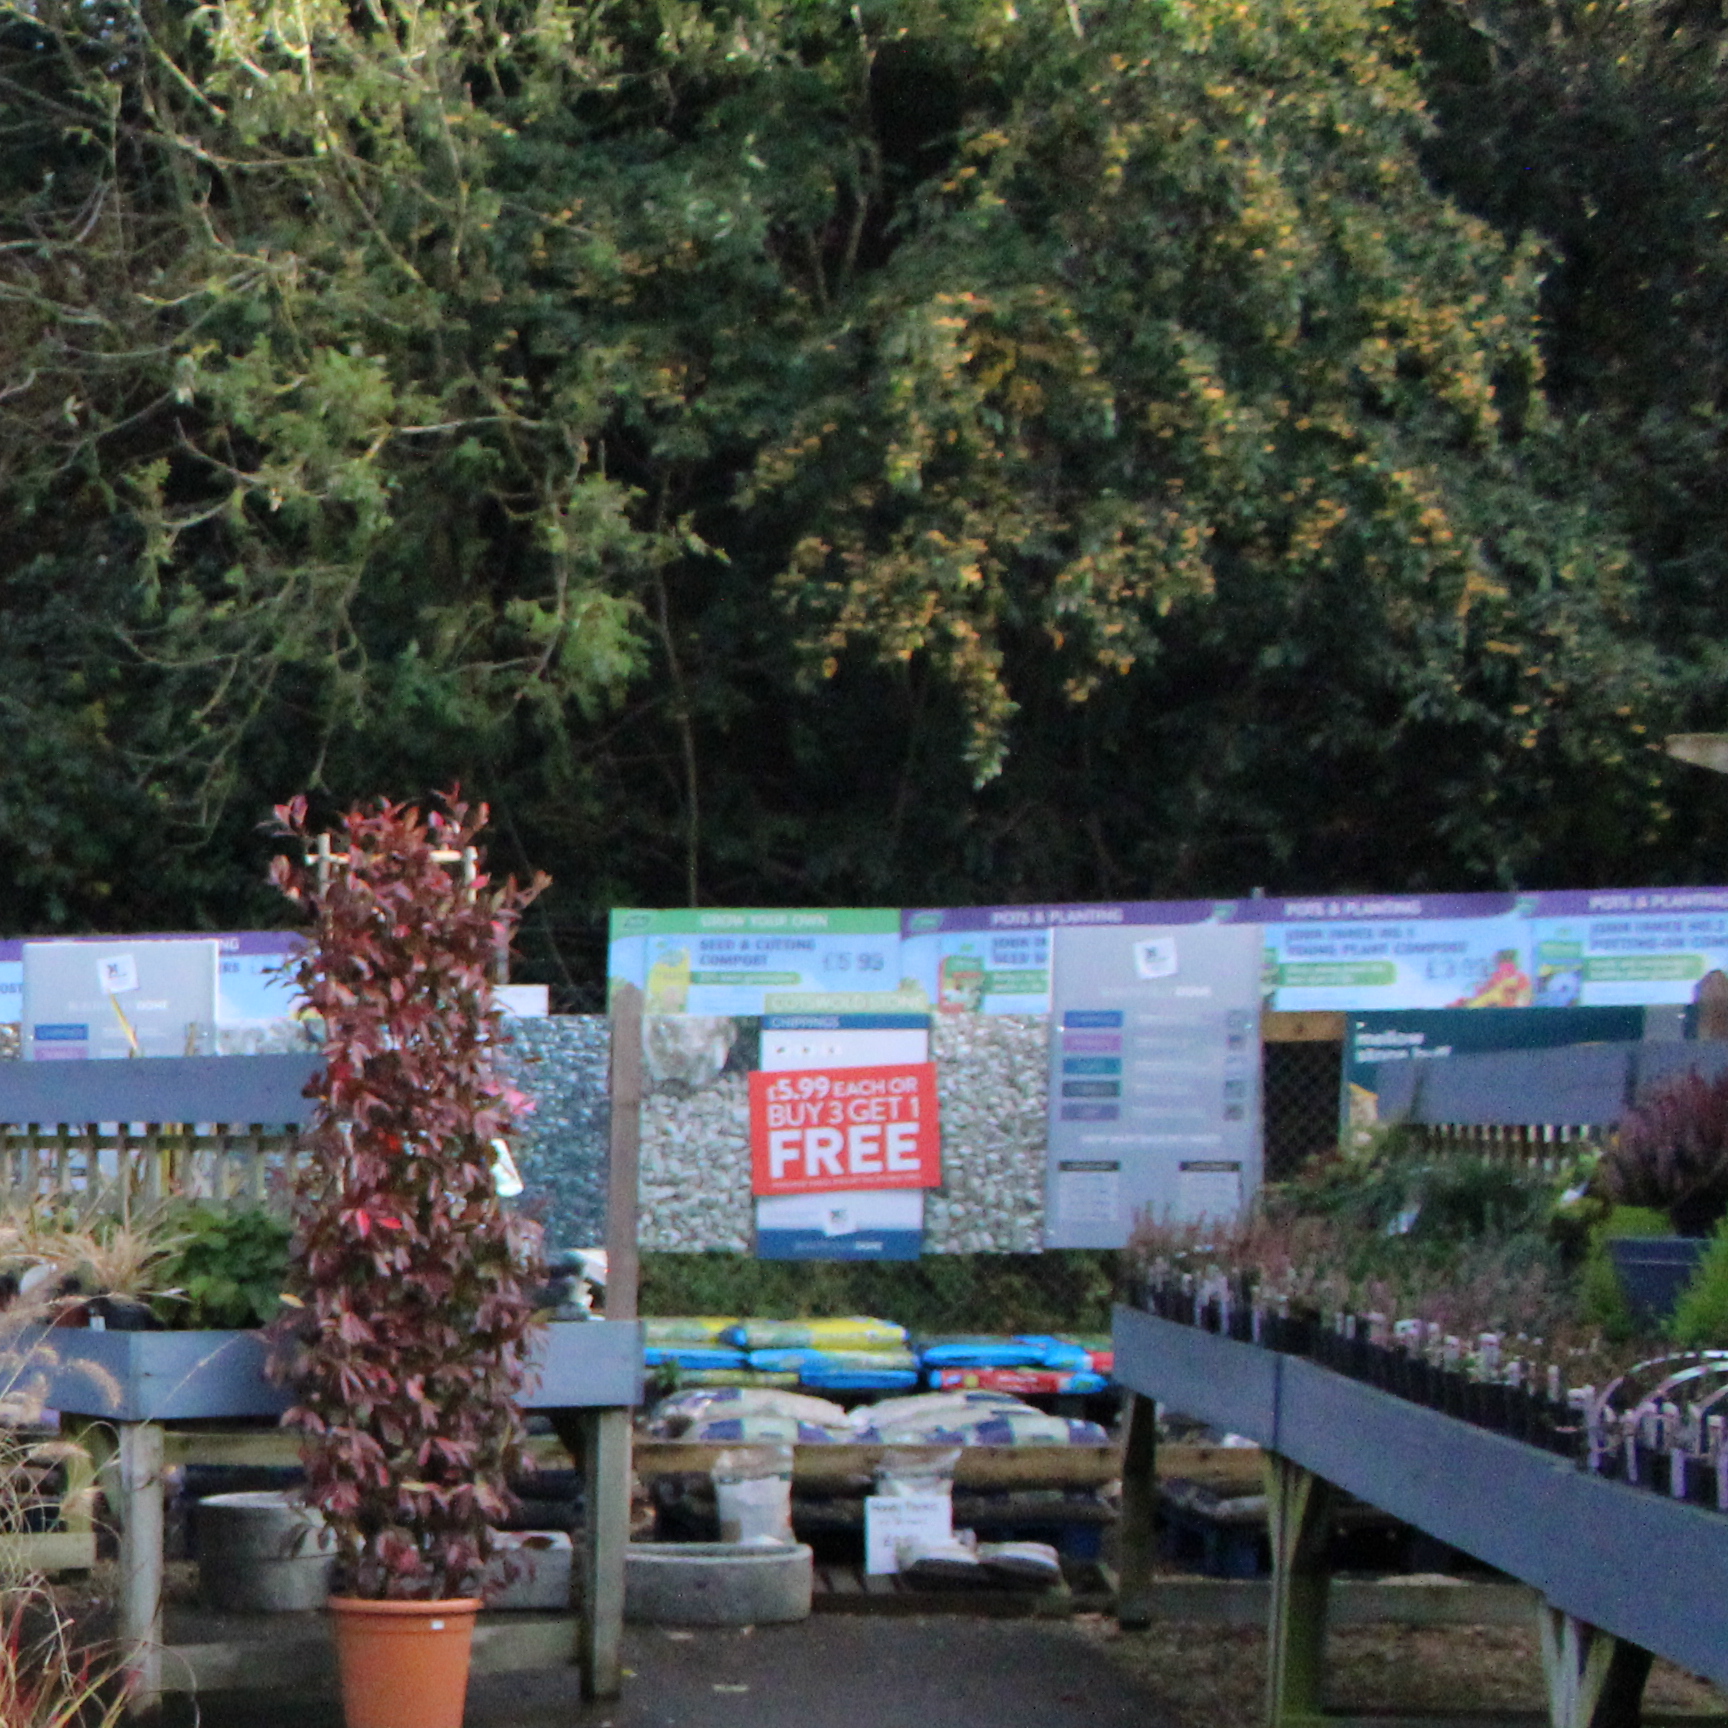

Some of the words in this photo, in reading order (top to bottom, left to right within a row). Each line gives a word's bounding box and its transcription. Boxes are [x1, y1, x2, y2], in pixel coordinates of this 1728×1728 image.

[700, 914, 744, 928] GROW
[750, 914, 788, 927] YOUR
[792, 913, 829, 927] OWN
[992, 910, 1030, 925] POTS
[1034, 910, 1046, 924] &
[1049, 908, 1124, 923] PLANTING
[699, 954, 768, 967] COMPOST
[771, 1016, 841, 1029] CHIPPINGS
[766, 1076, 832, 1103] £5.99
[833, 1080, 887, 1098] EACH
[888, 1076, 919, 1094] OR
[766, 1100, 825, 1129] BUY
[828, 1099, 845, 1125] 3
[847, 1096, 904, 1122] GET
[909, 1096, 921, 1118] 1
[768, 1121, 922, 1180] FREE
